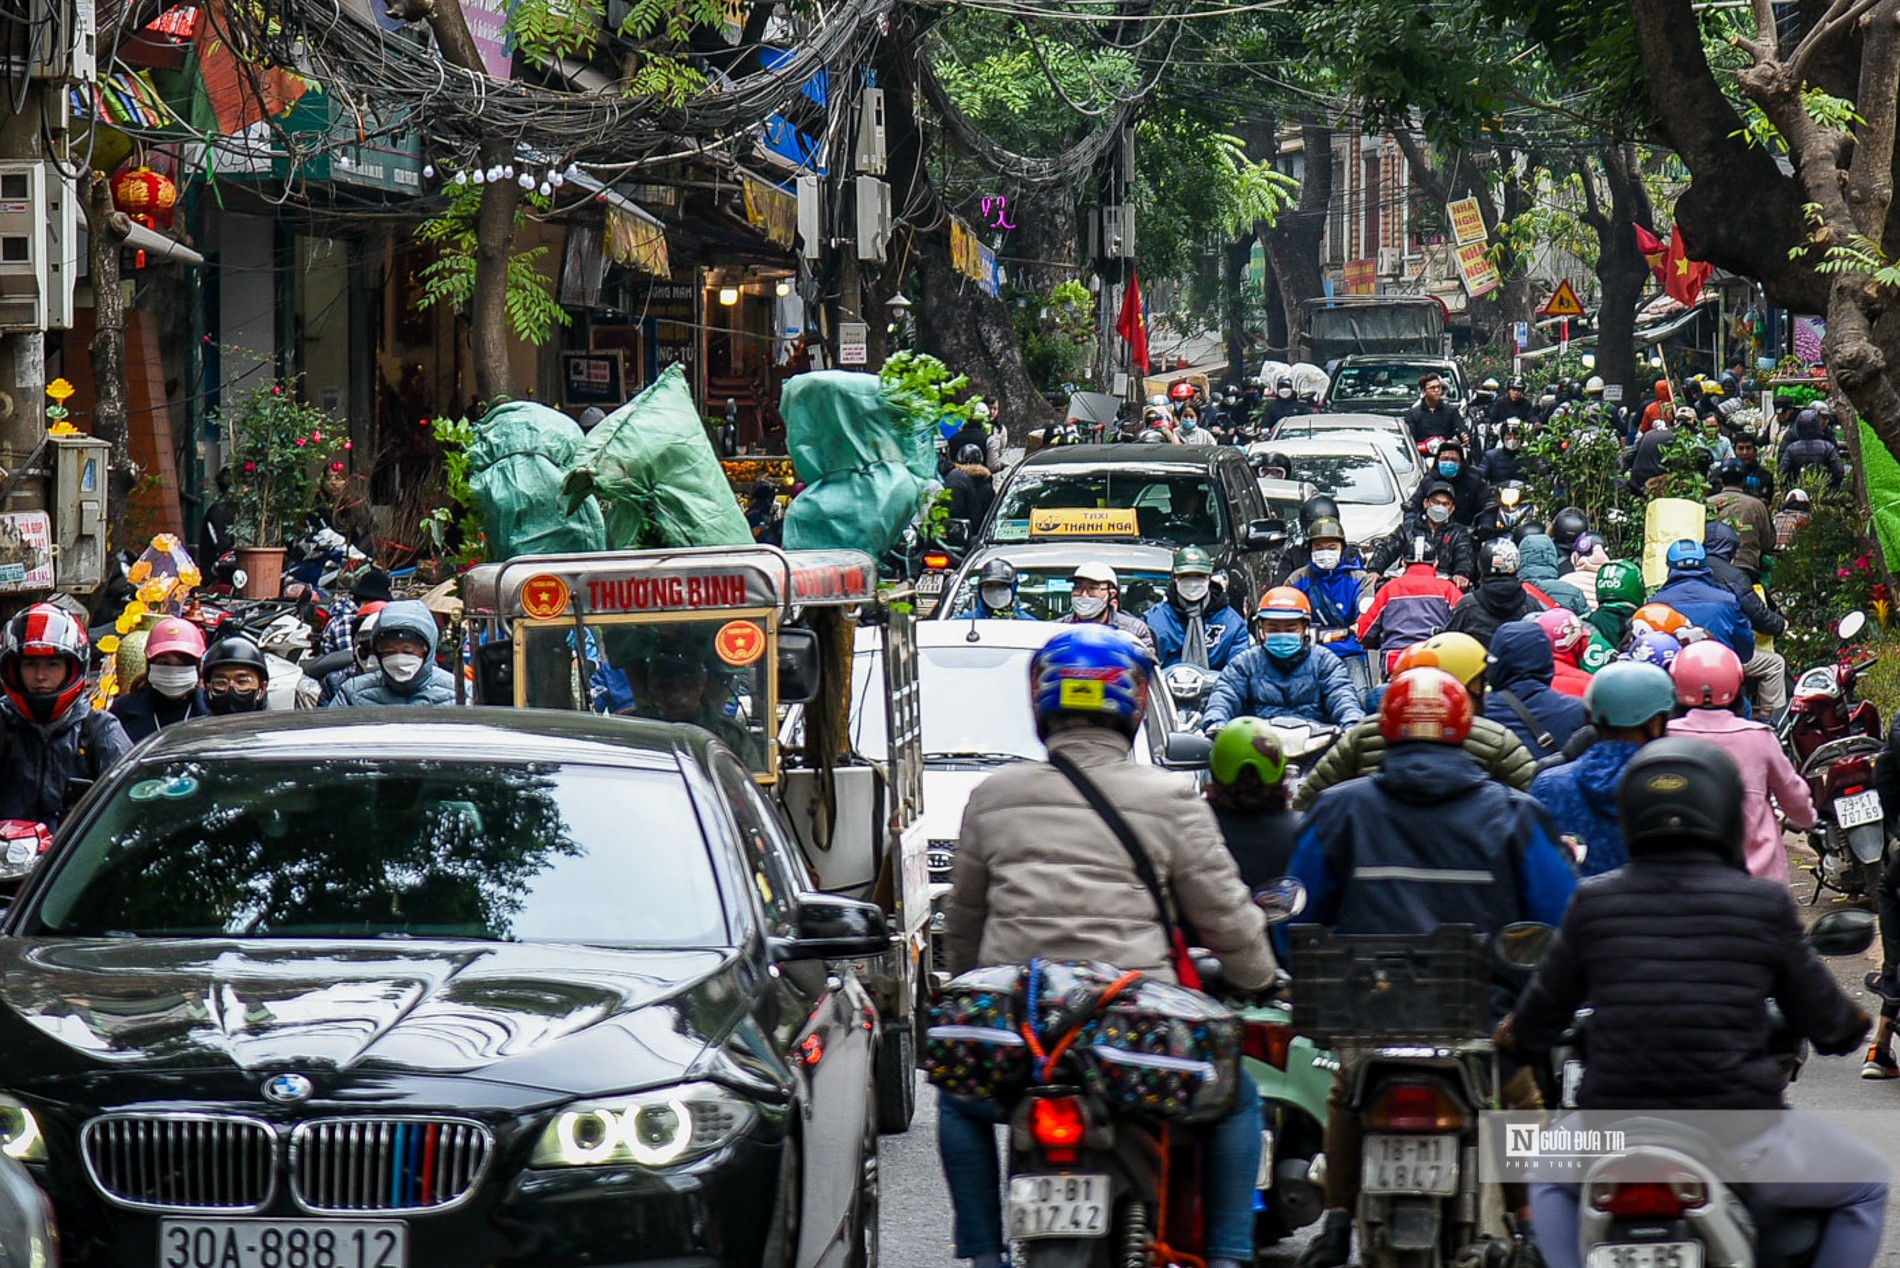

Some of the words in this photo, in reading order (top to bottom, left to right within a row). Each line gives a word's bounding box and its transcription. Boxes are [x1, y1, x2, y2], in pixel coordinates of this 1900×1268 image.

[1063, 522, 1103, 532] THANH
[1107, 521, 1132, 531] NGA
[1083, 512, 1109, 520] TAXI
[587, 575, 684, 611] THƯƠNG
[686, 574, 747, 608] BINH
[1597, 578, 1622, 589] Grab
[1583, 643, 1619, 667] Gr
[1027, 1178, 1093, 1202] 0-B1
[167, 1226, 398, 1268] 30A-888.12
